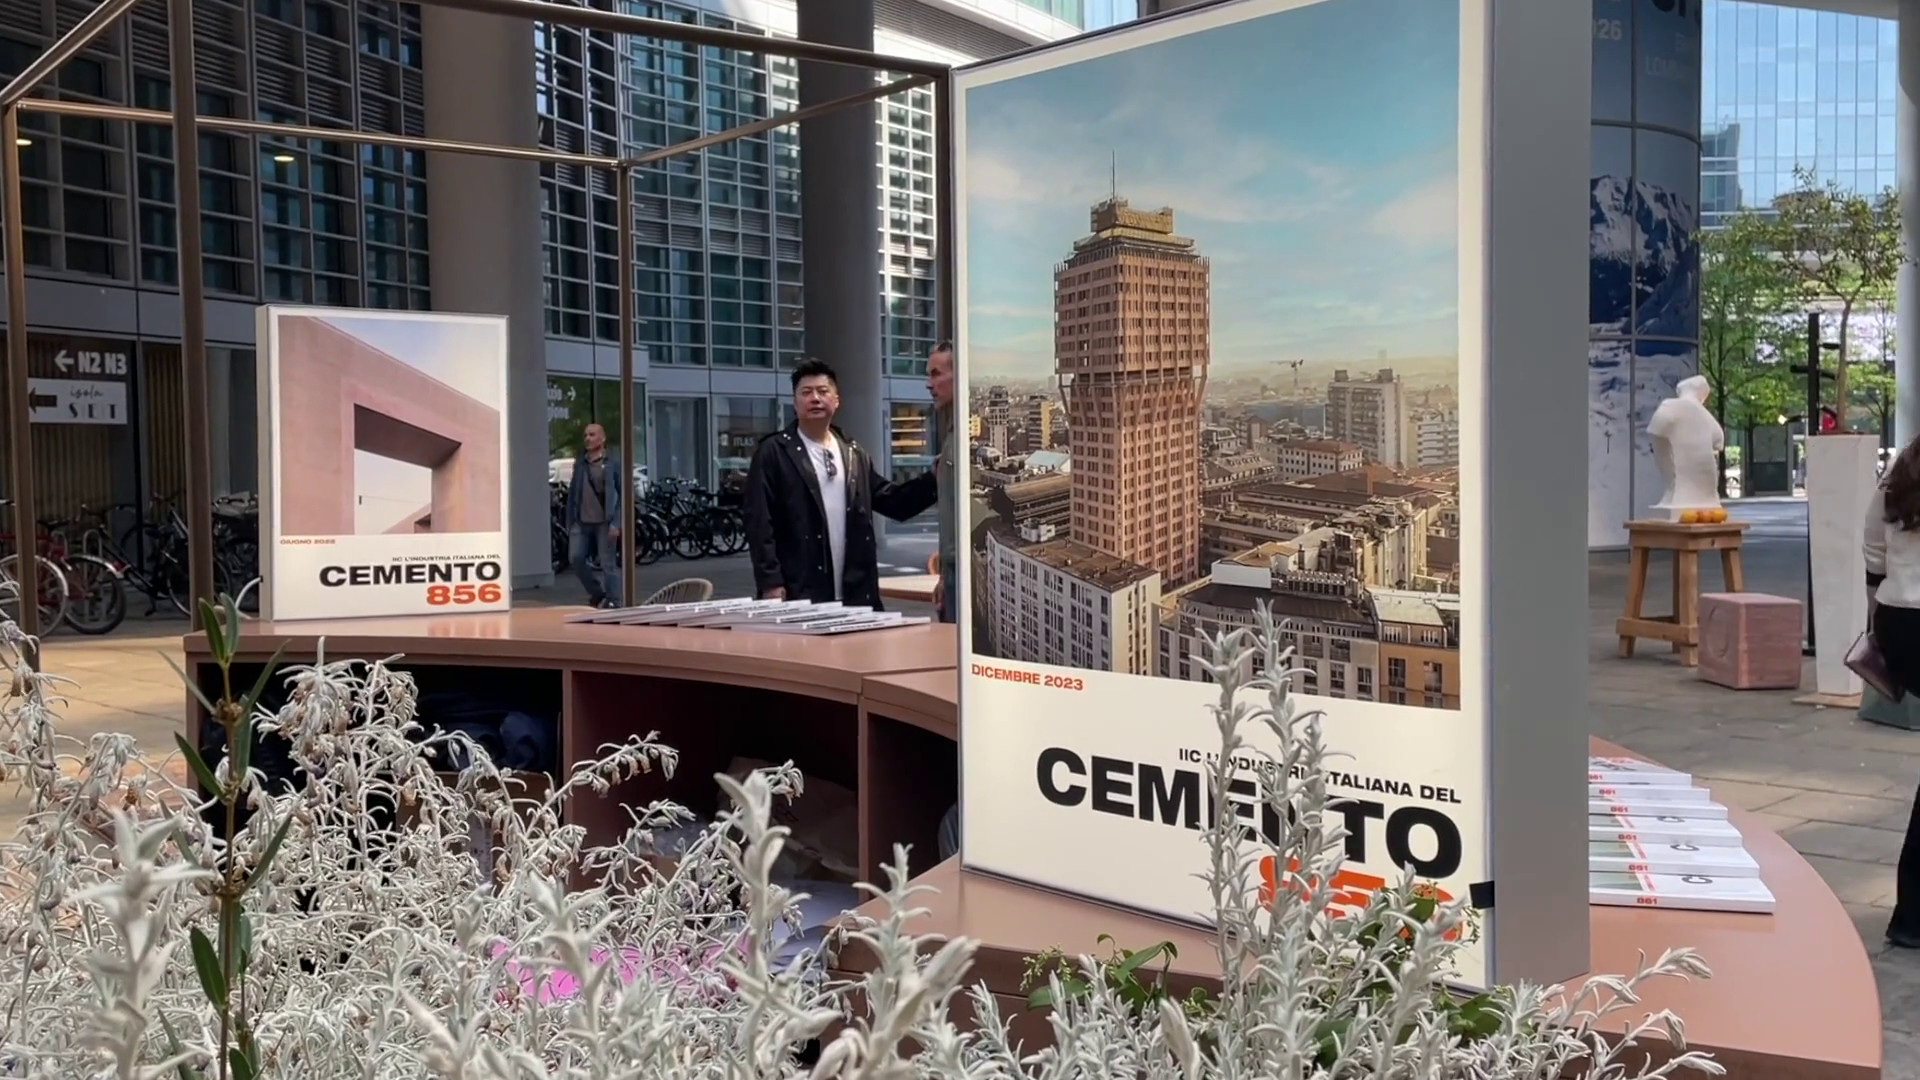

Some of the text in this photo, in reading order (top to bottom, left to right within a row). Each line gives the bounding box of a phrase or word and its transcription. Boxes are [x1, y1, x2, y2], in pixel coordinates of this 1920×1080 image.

[78, 351, 127, 375] N2 N3
[319, 561, 502, 587] CEMENTO
[427, 583, 502, 605] 856
[971, 663, 1084, 692] DICEMBRE 2023
[1179, 748, 1202, 763] IIC
[1325, 771, 1414, 798] ITALIANA
[1420, 784, 1462, 804] DEL
